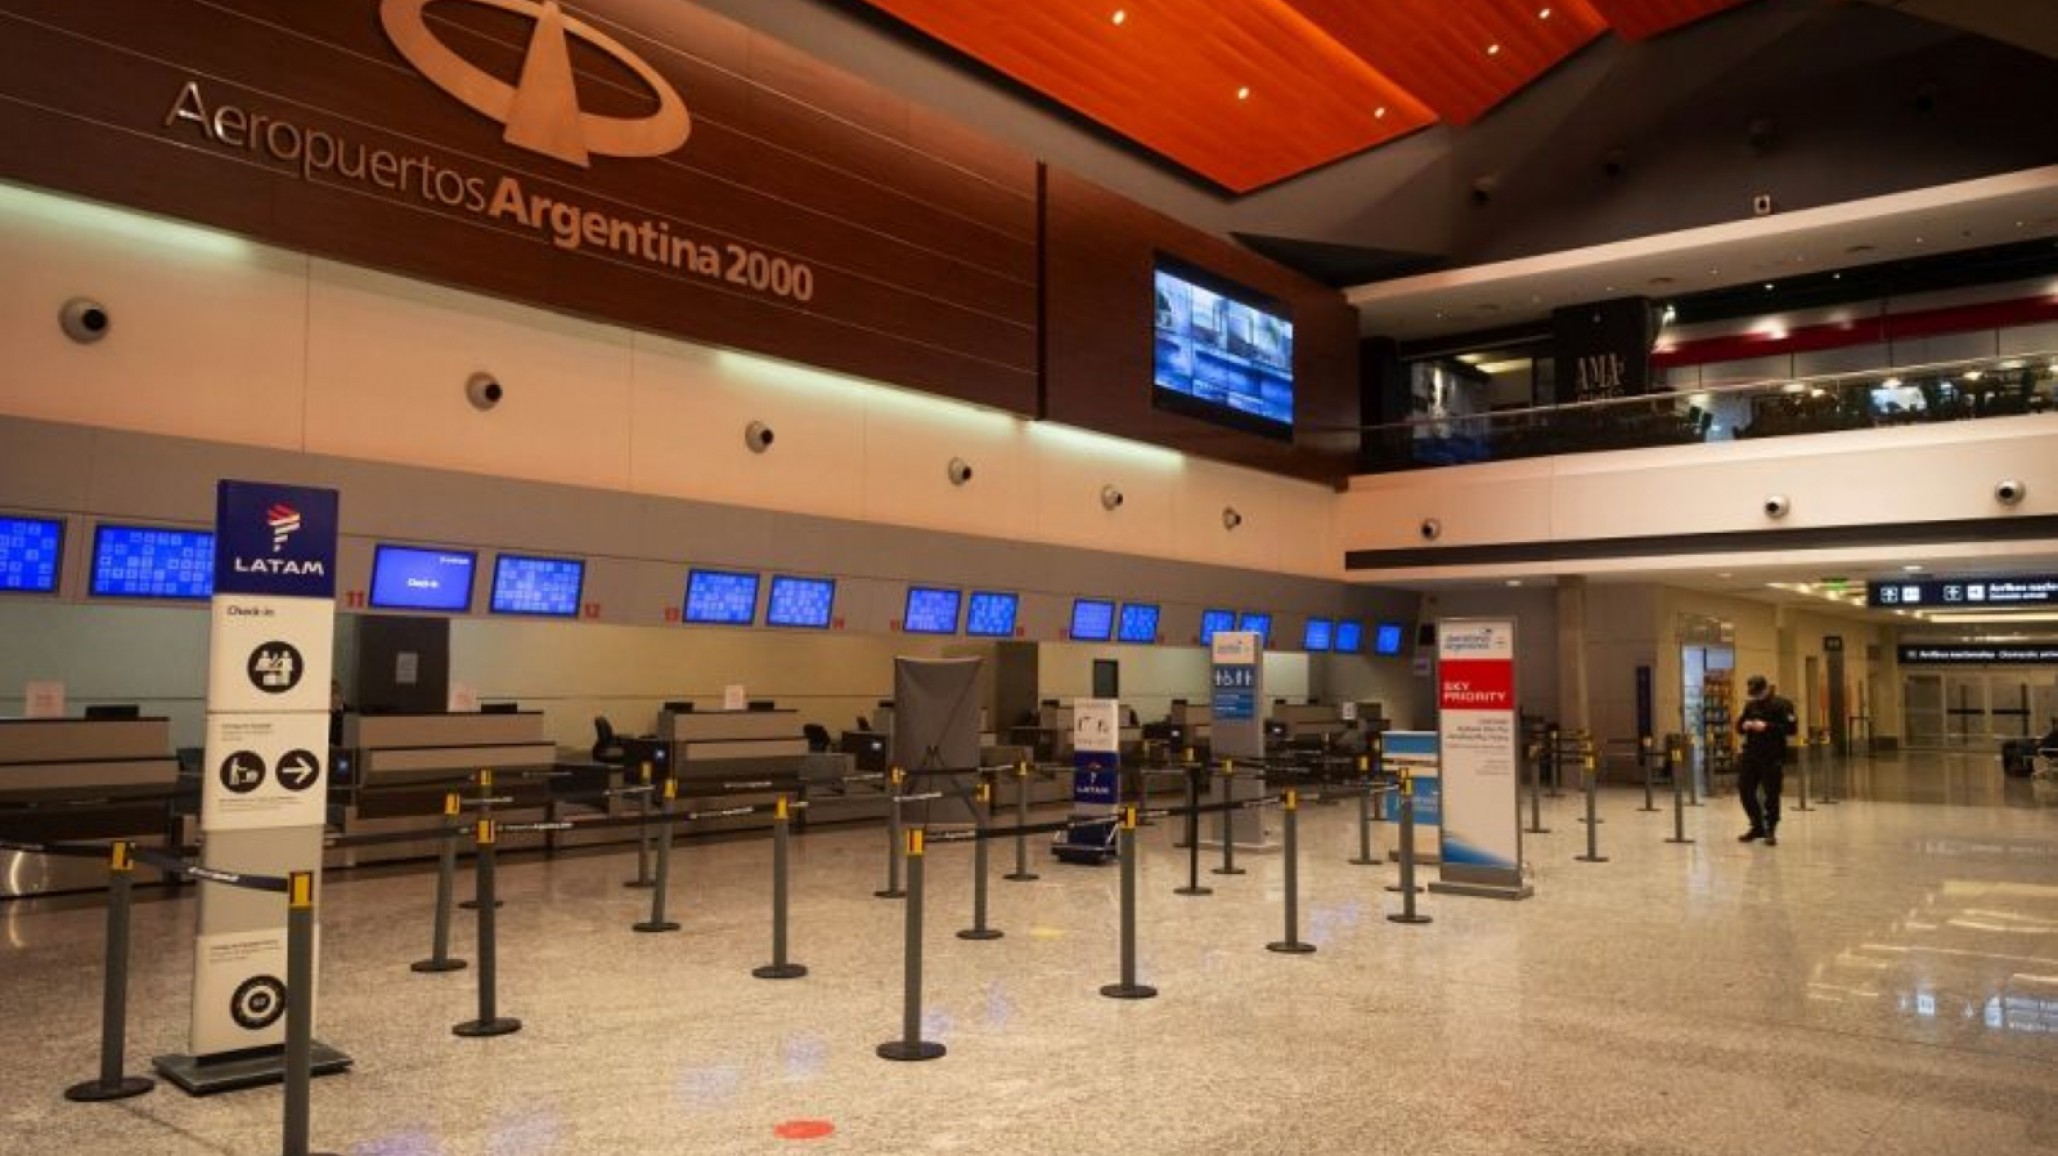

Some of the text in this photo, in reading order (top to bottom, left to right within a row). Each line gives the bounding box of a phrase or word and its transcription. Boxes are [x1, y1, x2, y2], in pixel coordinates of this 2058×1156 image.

[724, 244, 814, 301] 2000
[234, 557, 325, 577] LATAM
[1444, 691, 1507, 703] PRIORITY
